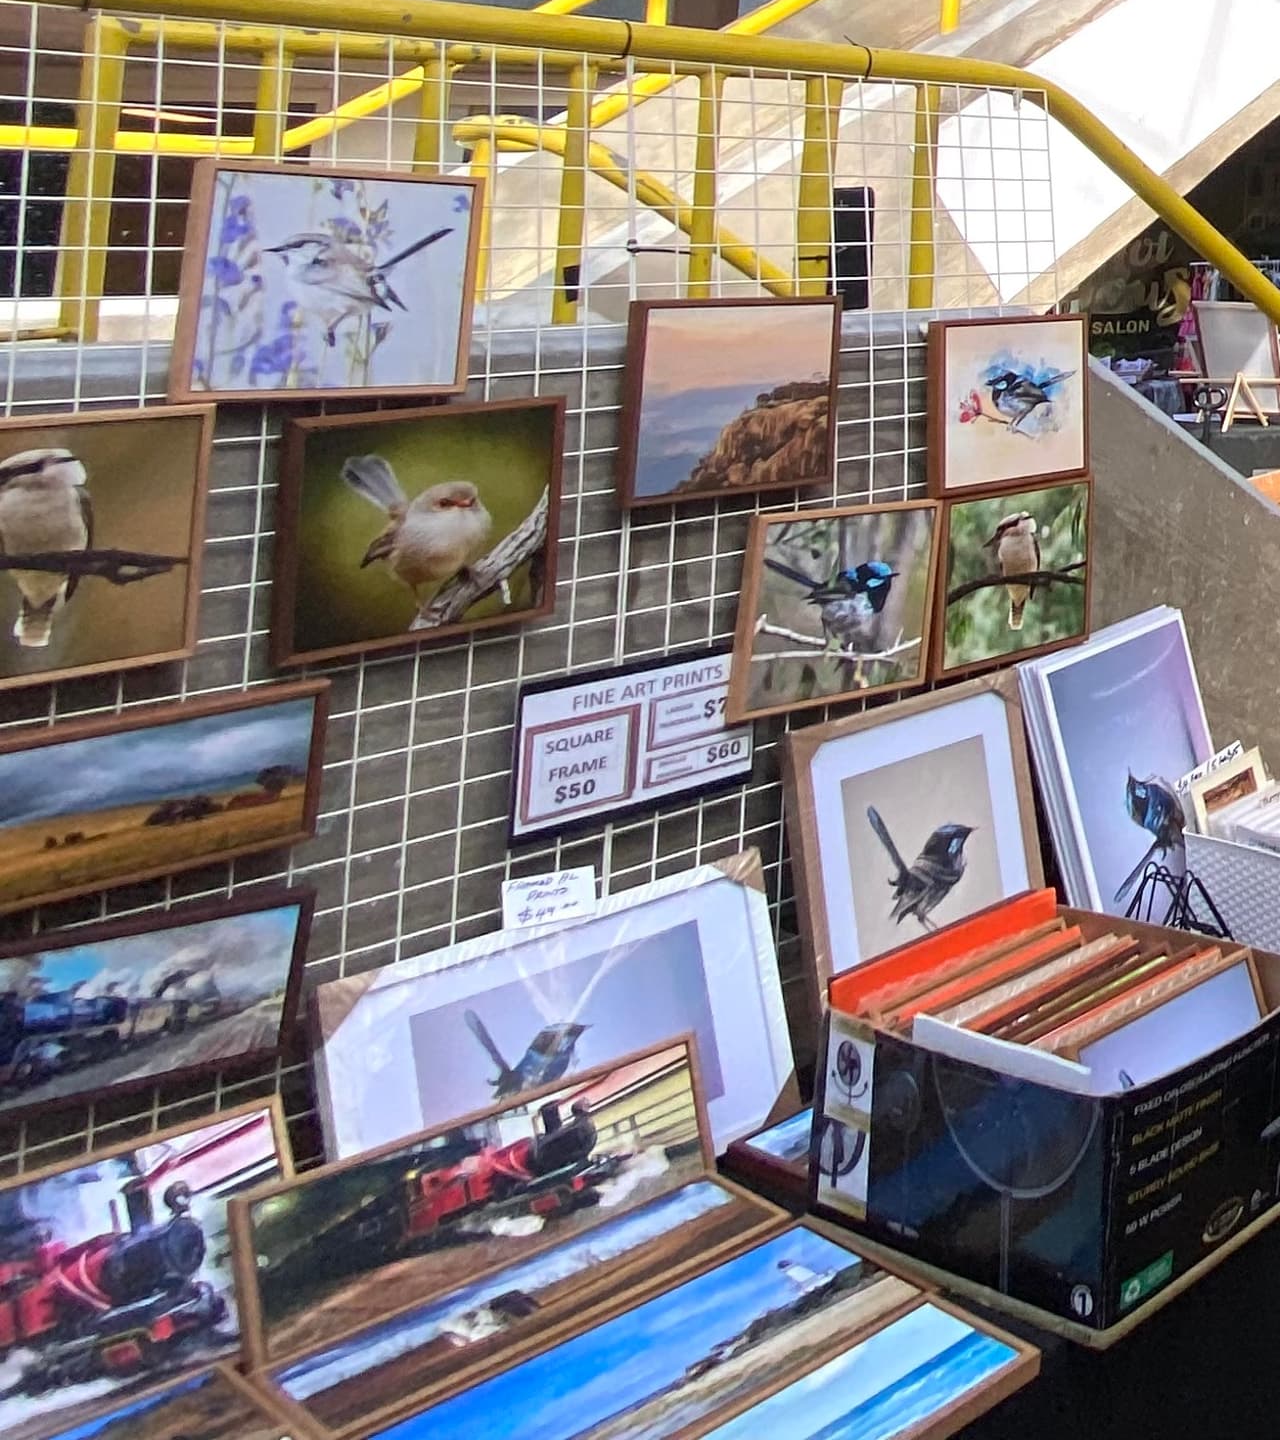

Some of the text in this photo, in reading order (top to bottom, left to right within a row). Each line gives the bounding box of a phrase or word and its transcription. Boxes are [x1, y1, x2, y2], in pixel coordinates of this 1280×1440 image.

[1092, 320, 1150, 334] SALON
[572, 664, 723, 711] FINE ART PRINTS
[545, 727, 615, 754] SQUARE
[707, 740, 741, 763] $60
[548, 756, 608, 782] FRAME
[554, 779, 596, 803] $50
[1134, 1096, 1162, 1115] FIXED
[1132, 1125, 1165, 1146] BLACK
[1137, 1148, 1169, 1171] BLADE
[1170, 1127, 1202, 1153] DESIGN
